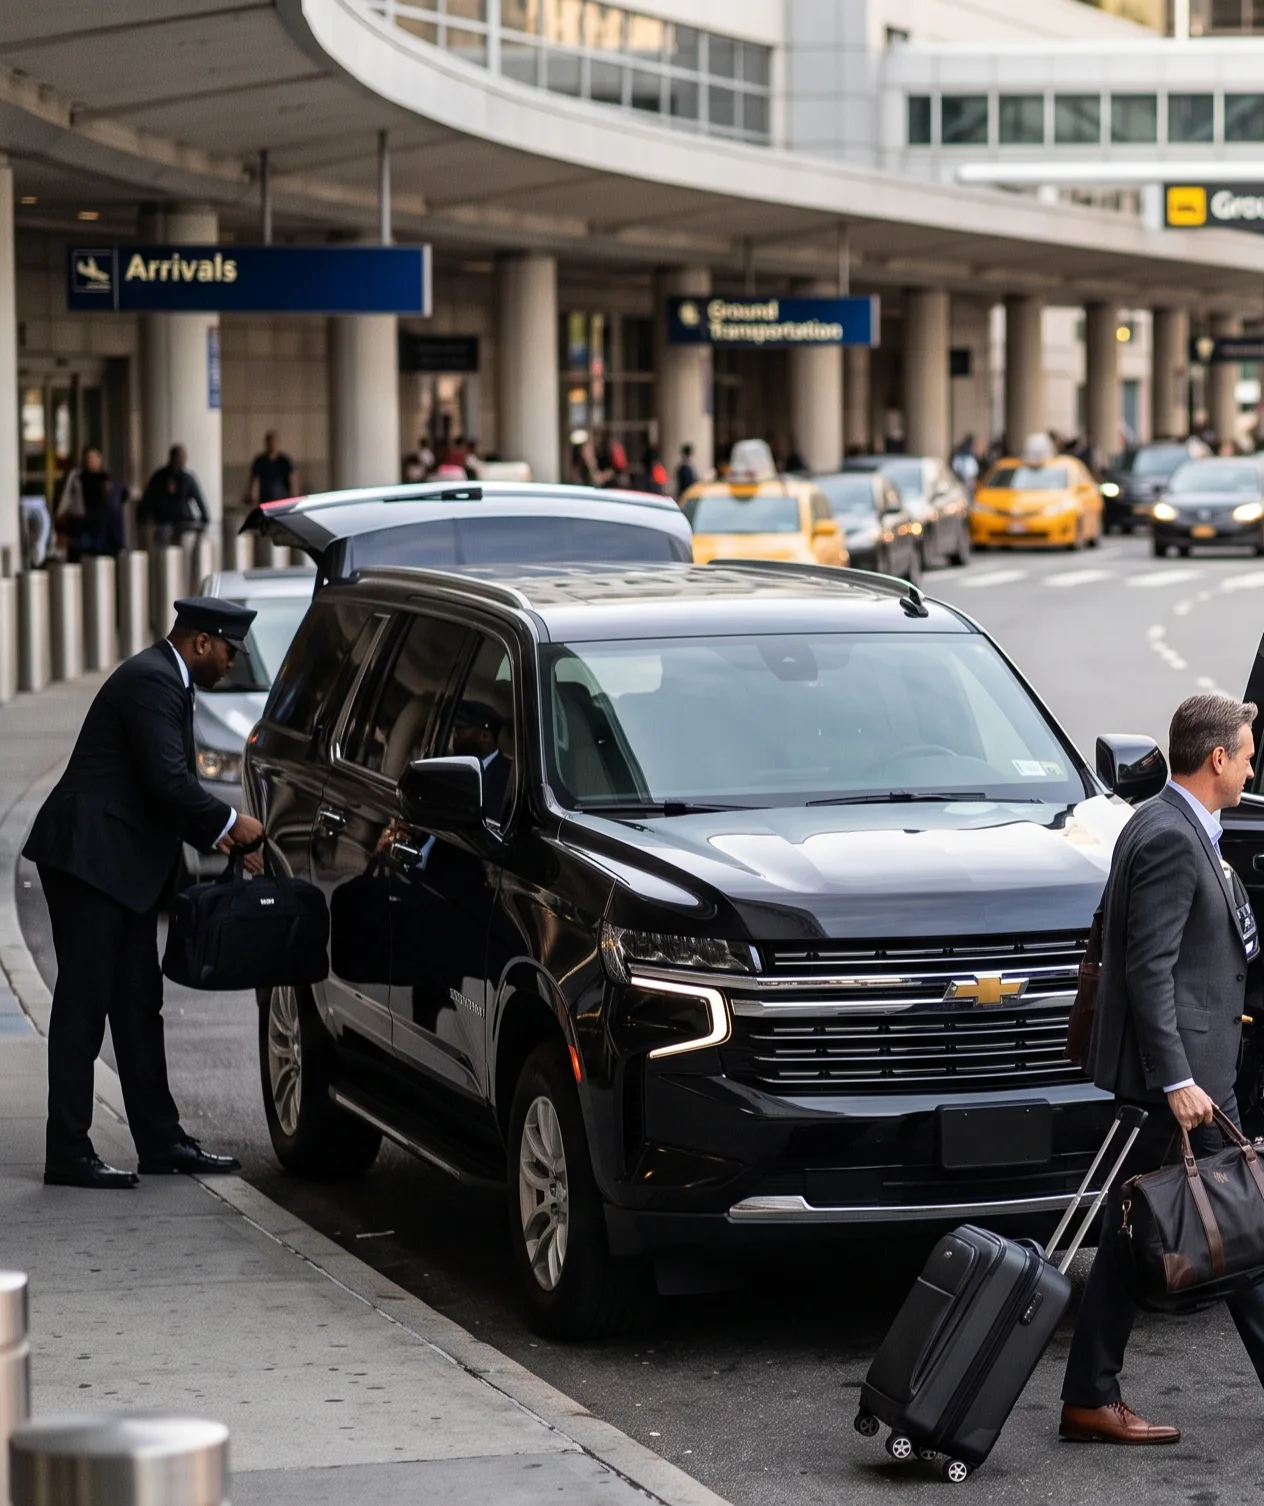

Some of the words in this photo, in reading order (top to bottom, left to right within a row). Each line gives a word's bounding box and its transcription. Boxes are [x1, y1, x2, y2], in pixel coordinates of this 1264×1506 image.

[125, 253, 238, 282] Arrivals
[707, 298, 779, 322] Ground
[708, 319, 844, 344] Transportation
